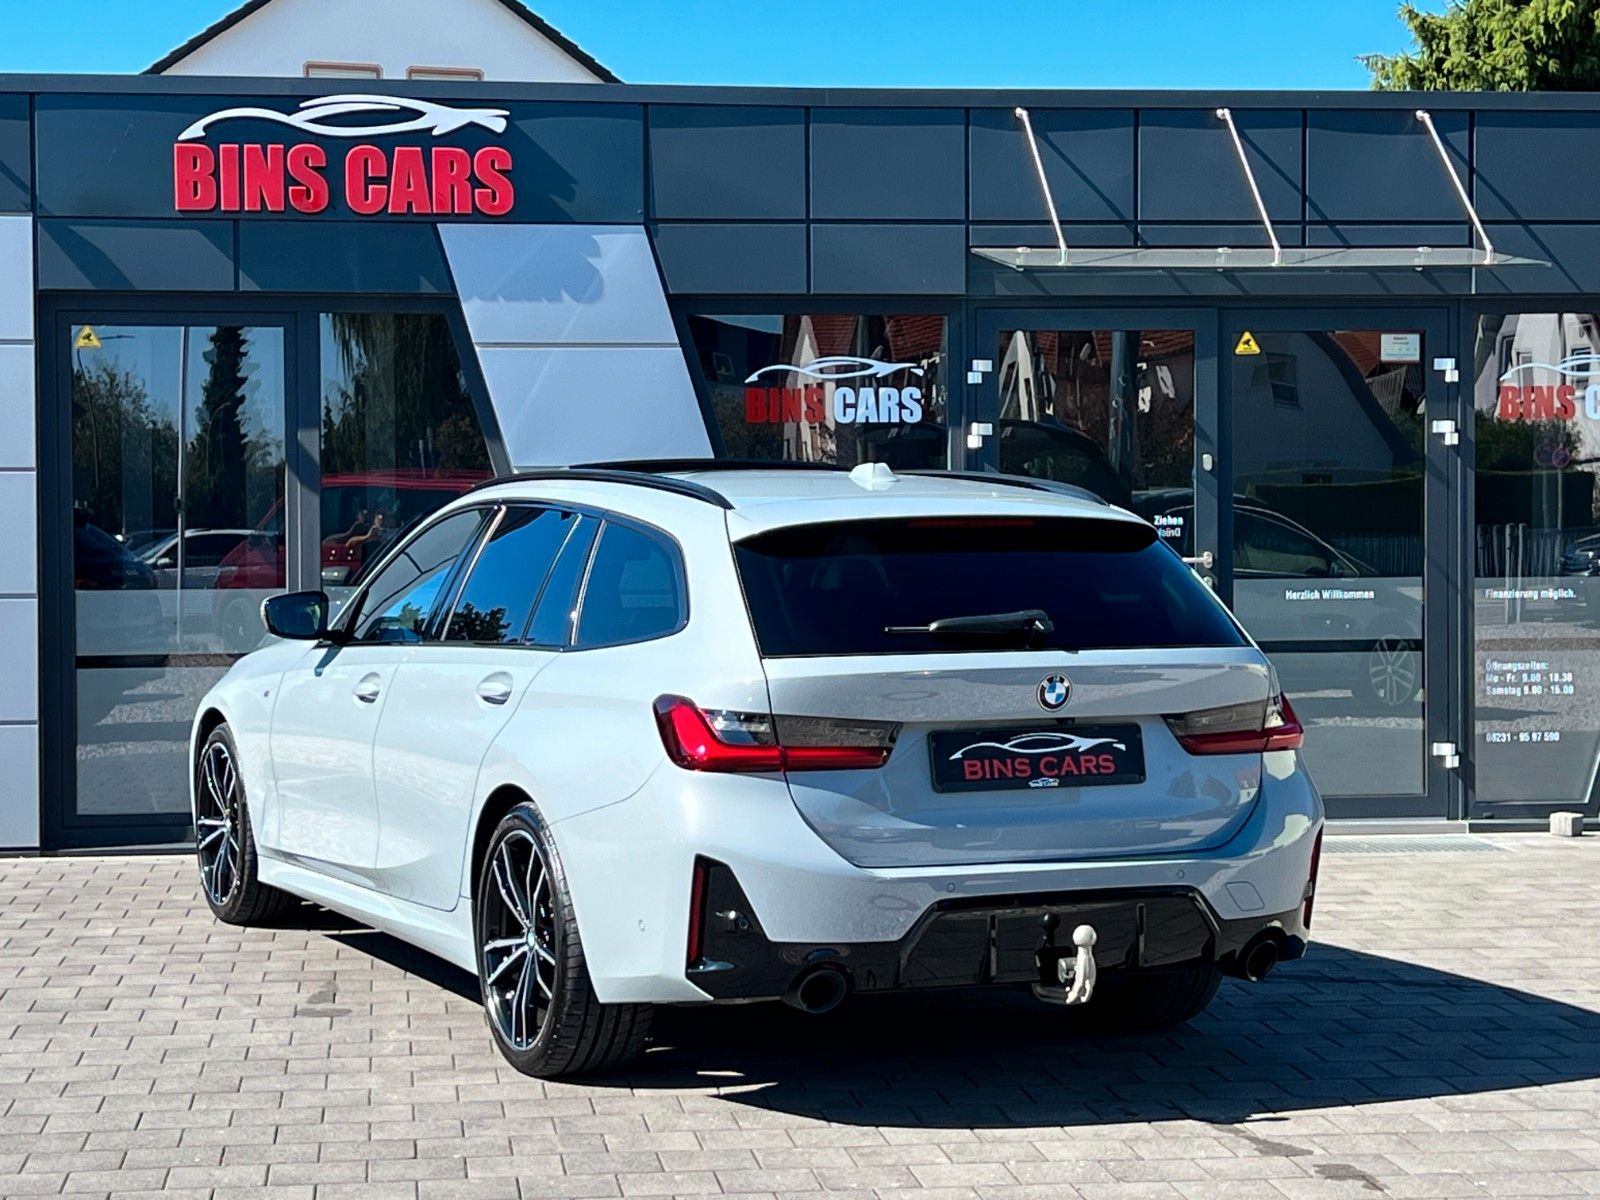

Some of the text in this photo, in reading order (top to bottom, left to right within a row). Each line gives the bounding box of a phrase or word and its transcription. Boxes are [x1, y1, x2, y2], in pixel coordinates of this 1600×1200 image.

[174, 142, 514, 216] BINS CARS
[745, 386, 922, 424] BINS CARS
[1500, 385, 1576, 420] BINS
[1153, 515, 1184, 526] Ziehen
[1285, 590, 1375, 600] Herzlich Willkommen
[1485, 588, 1576, 600] Finanzierung möglich.
[1485, 686, 1521, 697] Samstag
[964, 755, 1116, 780] BINS CARS
